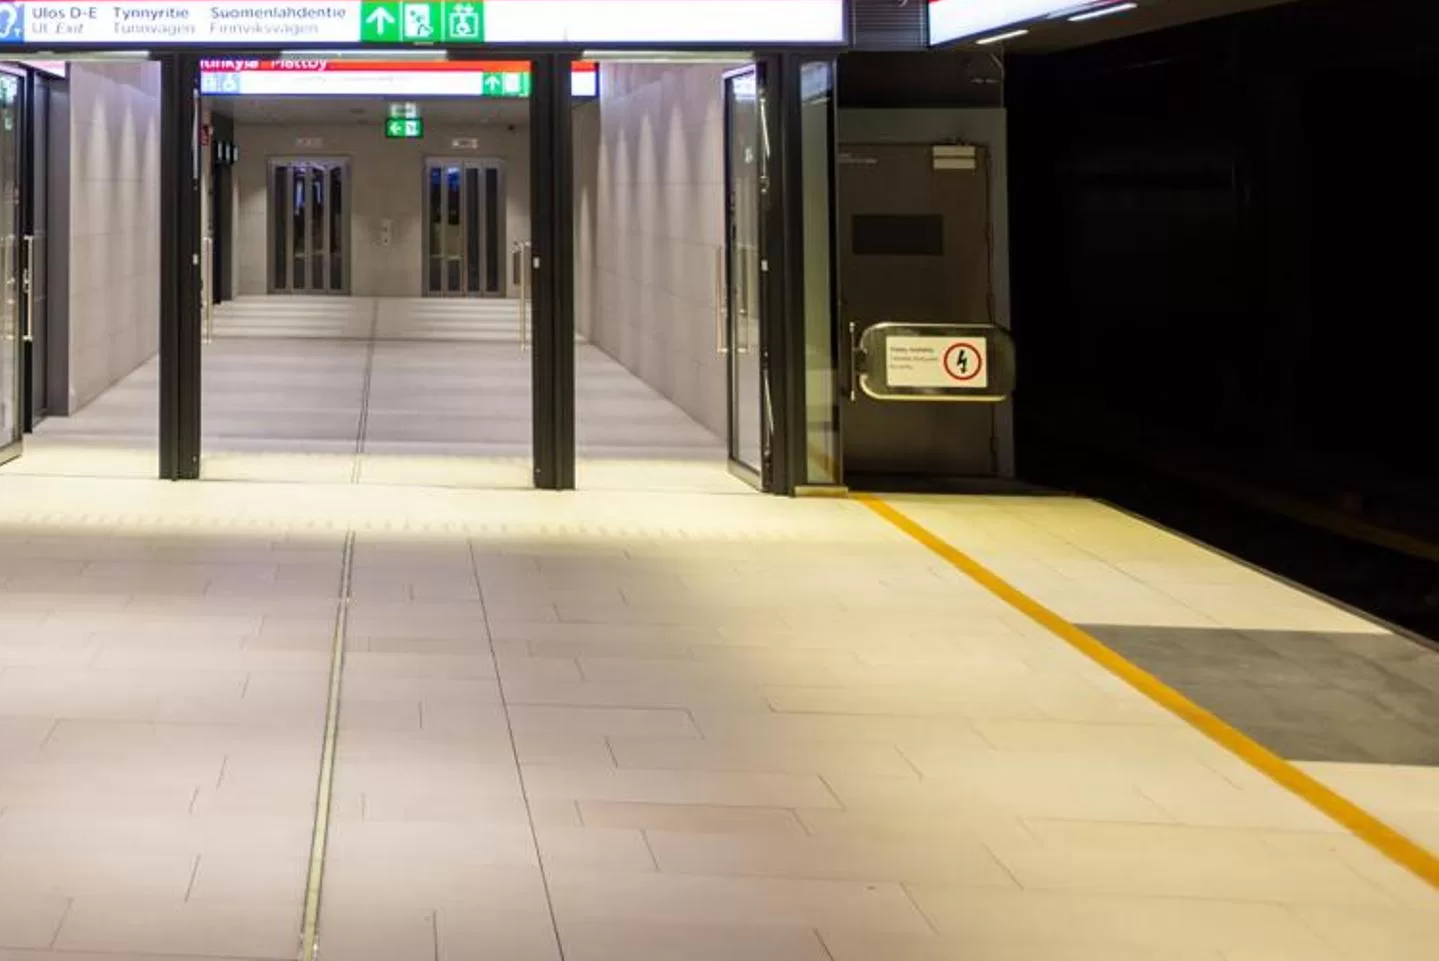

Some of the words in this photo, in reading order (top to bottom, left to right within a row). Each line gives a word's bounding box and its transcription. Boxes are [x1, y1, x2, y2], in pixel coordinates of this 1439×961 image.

[31, 6, 66, 20] Ulos
[113, 6, 191, 22] Tynnyritie
[210, 6, 347, 20] Suomenlahdentie
